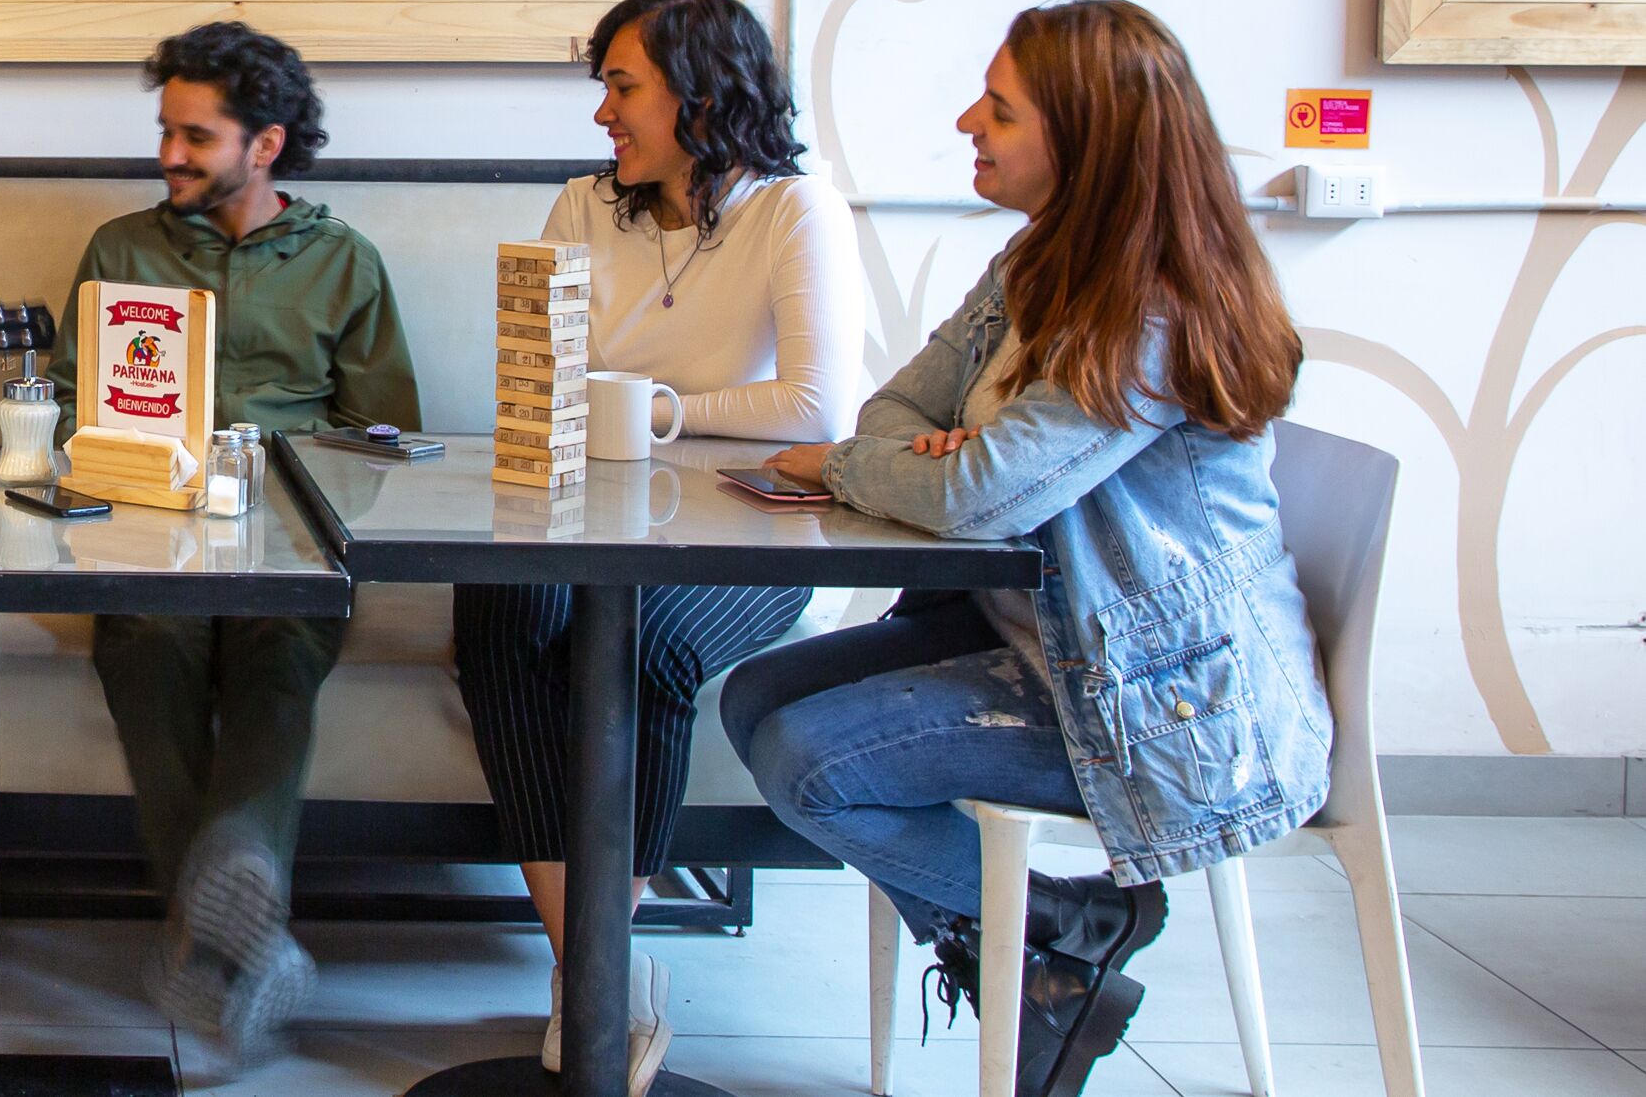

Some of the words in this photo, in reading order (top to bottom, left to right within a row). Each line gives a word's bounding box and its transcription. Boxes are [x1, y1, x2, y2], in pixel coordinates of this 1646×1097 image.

[119, 305, 170, 322] WELCOME
[113, 364, 176, 384] PARIWANA
[117, 397, 170, 416] BIENVENIDO
